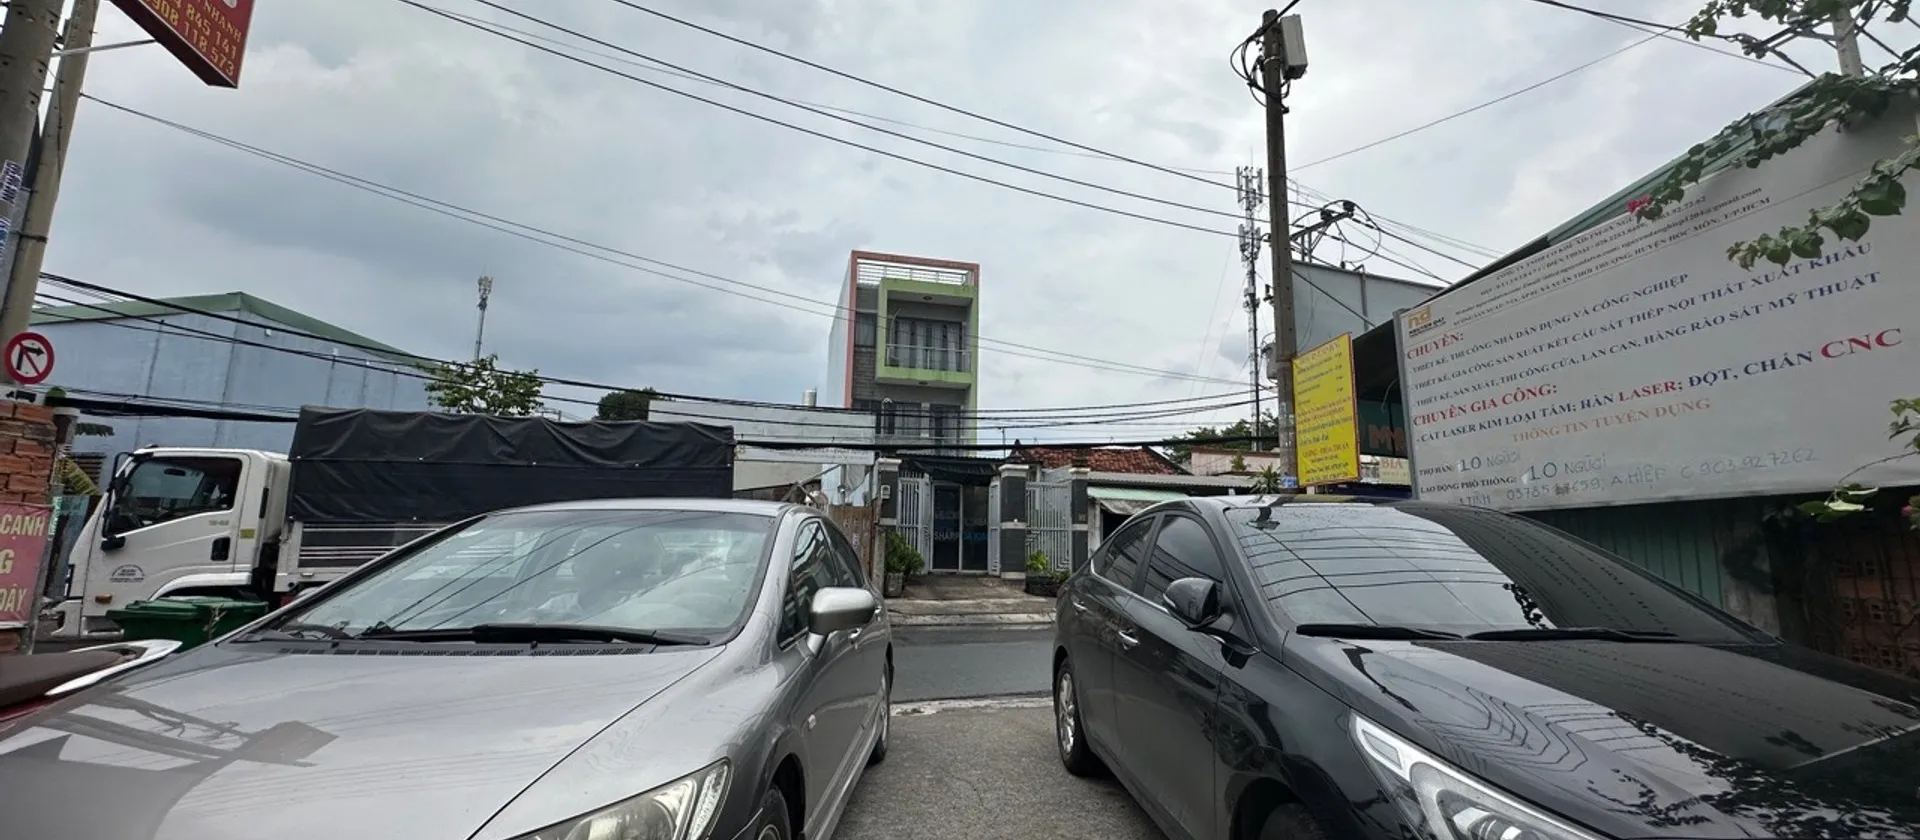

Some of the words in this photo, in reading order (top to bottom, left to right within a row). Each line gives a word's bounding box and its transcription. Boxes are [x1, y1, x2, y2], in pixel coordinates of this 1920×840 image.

[186, 4, 212, 36] 845
[216, 31, 237, 59] 141
[204, 2, 242, 43] NHANH
[184, 21, 208, 52] 118
[211, 46, 234, 77] 573
[1573, 304, 1590, 319] VÀ
[1592, 293, 1630, 313] CÔNG
[1632, 272, 1689, 298] NGHIỆP
[1626, 306, 1665, 325] THÉP
[1667, 296, 1697, 311] NỘI
[1407, 330, 1464, 360] CHUYÊN:
[1518, 363, 1549, 381] CÔNG
[1609, 338, 1642, 354] CAN,
[1643, 325, 1687, 345] HÀNG
[1690, 315, 1725, 332] RÀO
[1767, 293, 1799, 311] MỸ
[1803, 271, 1881, 300] THUẬT
[1412, 403, 1468, 427] CHUYÊN
[1469, 397, 1498, 414] GIA
[1501, 382, 1557, 406] CÔNG:
[1442, 424, 1477, 439] LASER
[1478, 418, 1503, 431] KIM
[1504, 410, 1537, 426] LOẠI
[1579, 394, 1615, 410] HÀN
[1617, 380, 1683, 402] LASER;
[1820, 328, 1903, 358] CNC
[1512, 424, 1561, 443] THÔNG
[1563, 421, 1589, 434] TIN
[1654, 397, 1712, 418] DỤNG
[1458, 455, 1482, 473] 10
[1528, 461, 1558, 481] 10
